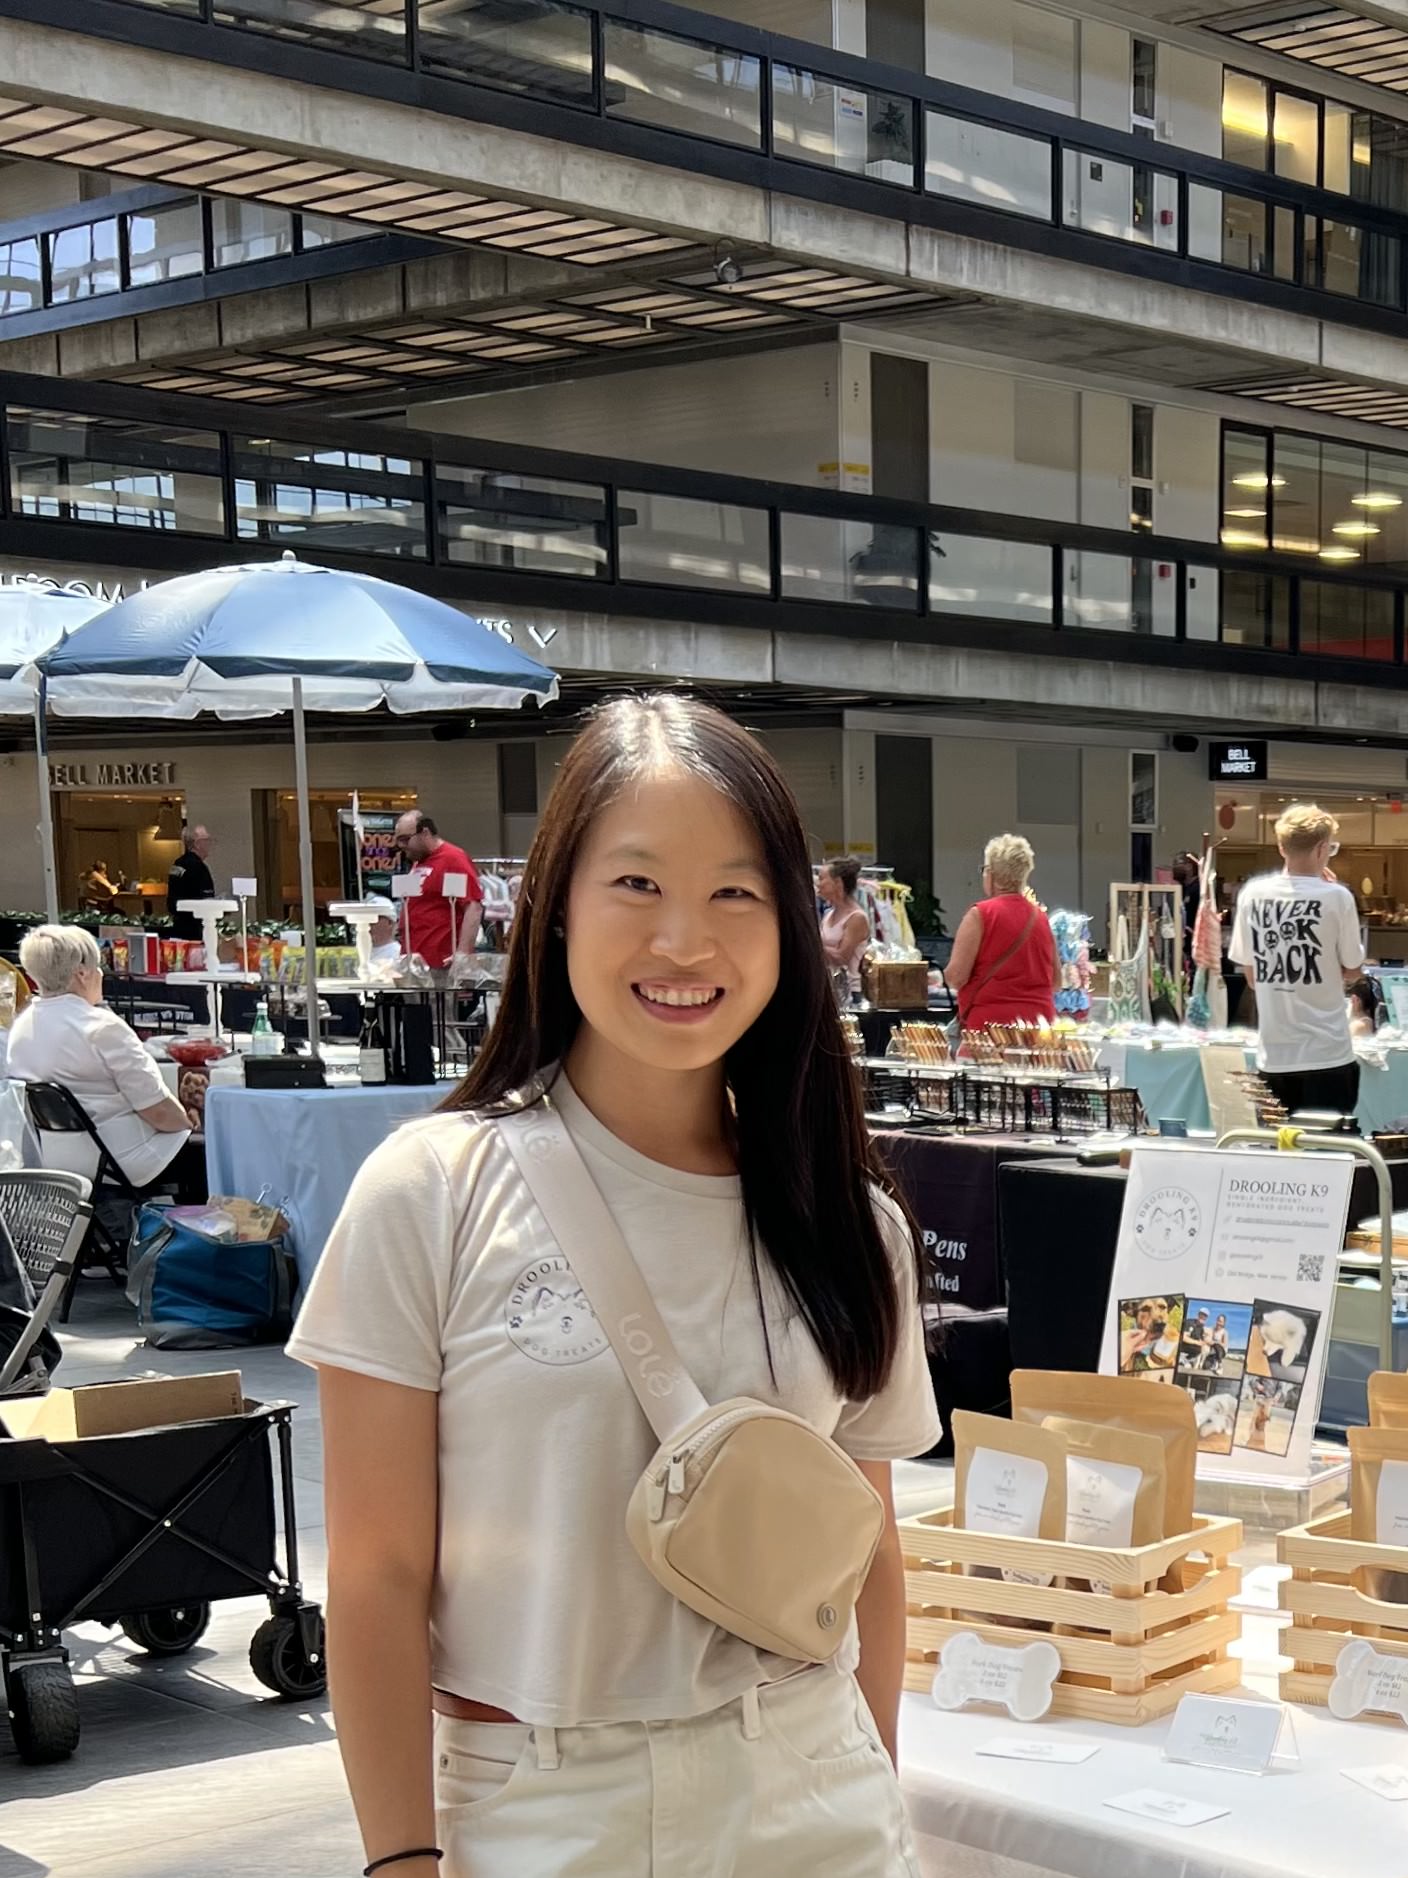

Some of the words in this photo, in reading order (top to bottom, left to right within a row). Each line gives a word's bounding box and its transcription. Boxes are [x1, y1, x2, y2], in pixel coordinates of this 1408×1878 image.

[1228, 749, 1250, 760] BELL
[49, 764, 86, 786] ELL
[96, 762, 174, 785] MARKET
[1221, 762, 1256, 773] MARKET
[1251, 899, 1322, 929] NEVER
[1255, 944, 1322, 985] BACK
[1229, 1178, 1307, 1197] DROOLING
[1310, 1183, 1329, 1198] K9
[511, 1259, 571, 1306] DROOLI
